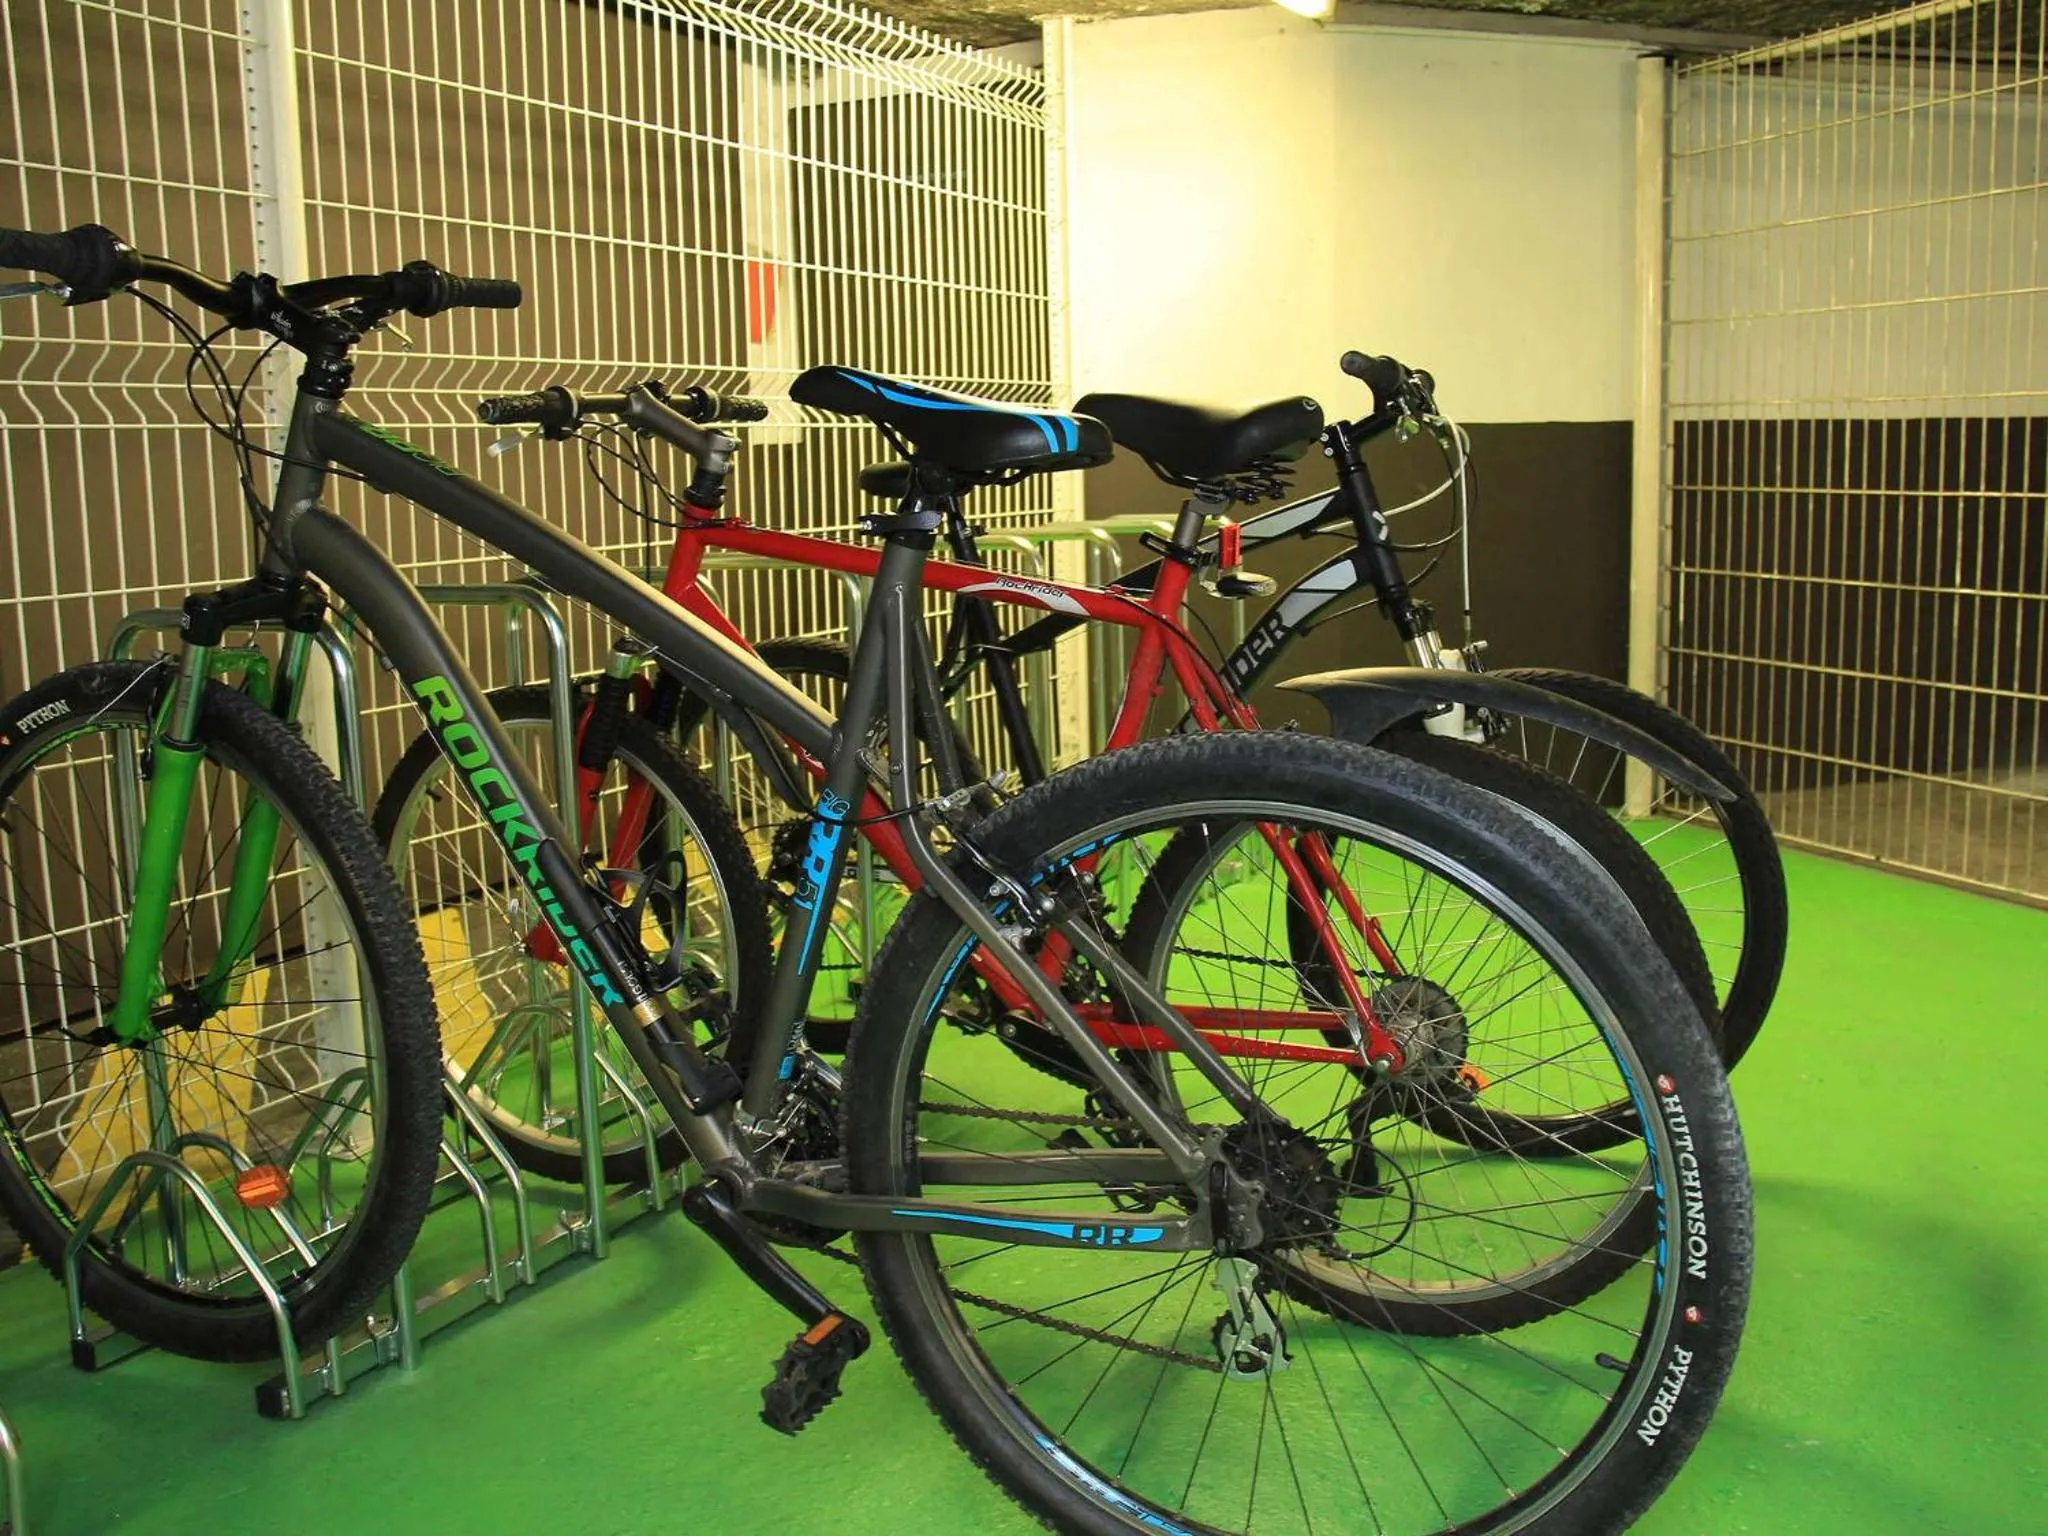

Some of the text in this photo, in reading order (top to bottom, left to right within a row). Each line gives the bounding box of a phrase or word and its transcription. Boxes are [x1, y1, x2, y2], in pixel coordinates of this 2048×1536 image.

[16, 699, 72, 735] PYTHON
[1661, 1094, 1708, 1280] HUTCHINSON
[1636, 1344, 1693, 1447] PYTHON
